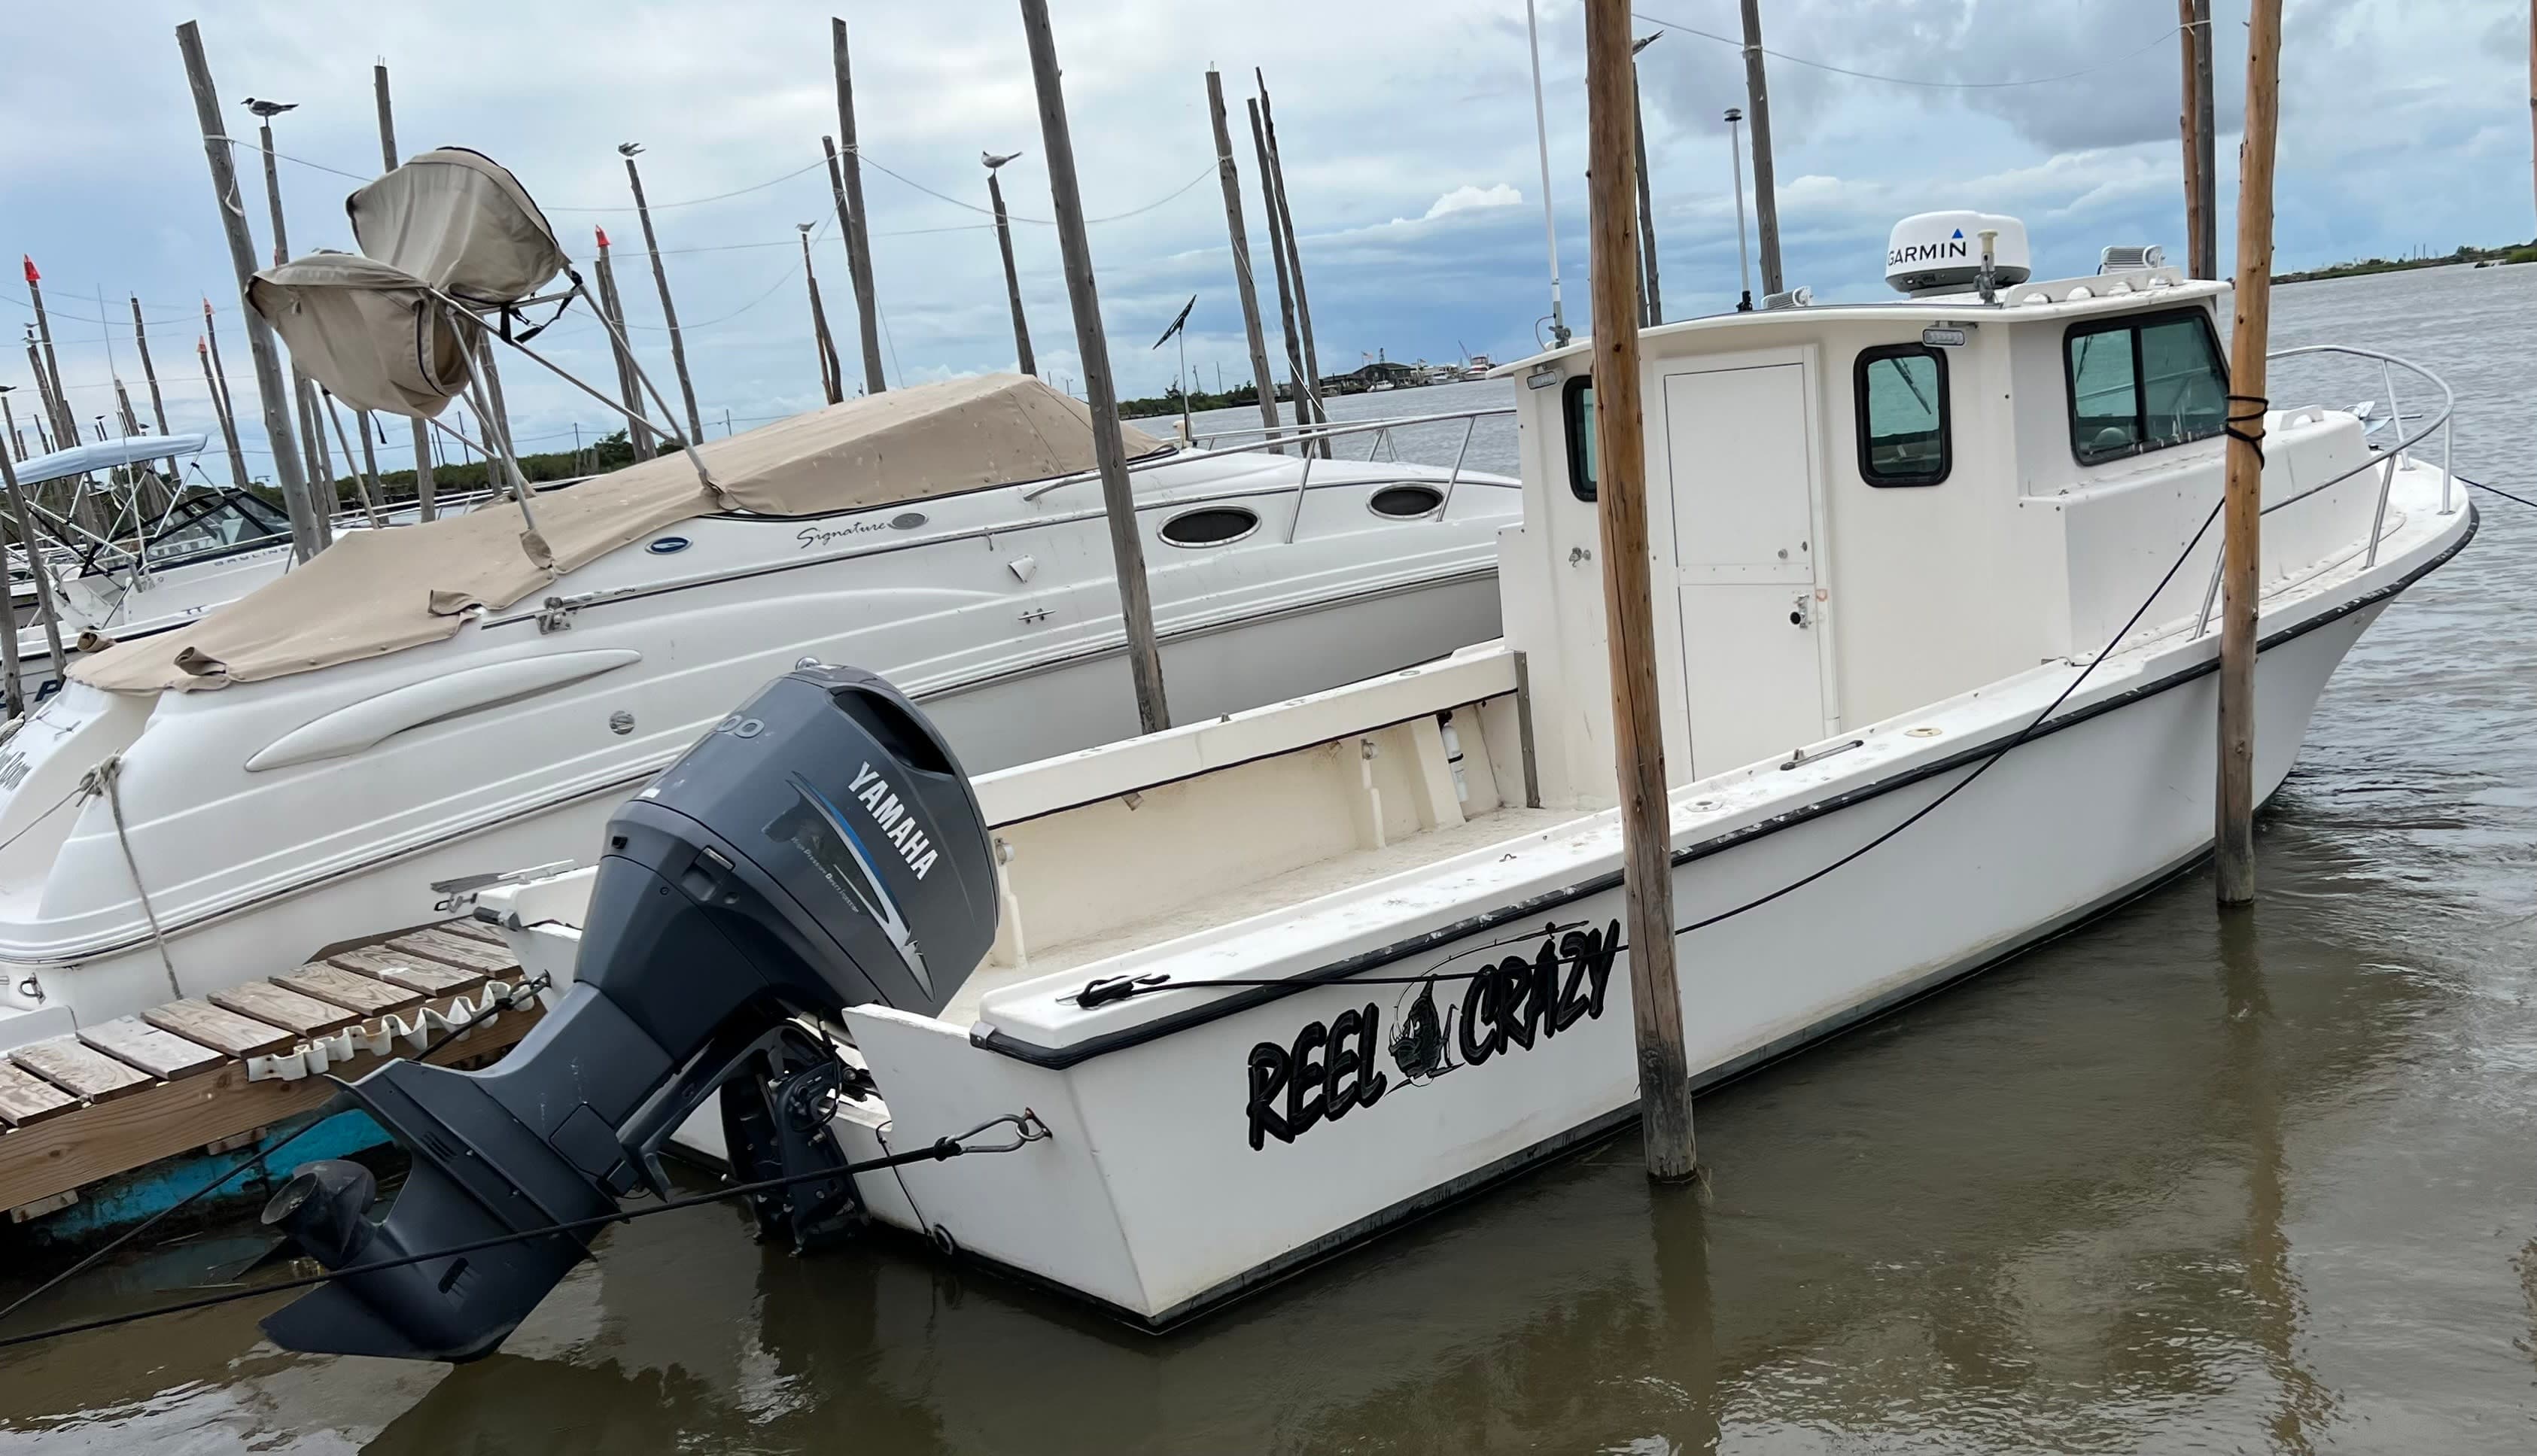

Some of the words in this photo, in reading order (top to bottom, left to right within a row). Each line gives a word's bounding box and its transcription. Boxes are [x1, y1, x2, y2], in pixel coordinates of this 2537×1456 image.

[1888, 242, 1967, 266] GARMIN
[796, 521, 887, 549] Signature
[848, 761, 938, 880] YAMAHA
[1246, 1002, 1387, 1151] REEL
[1459, 918, 1620, 1066] CRAZY
